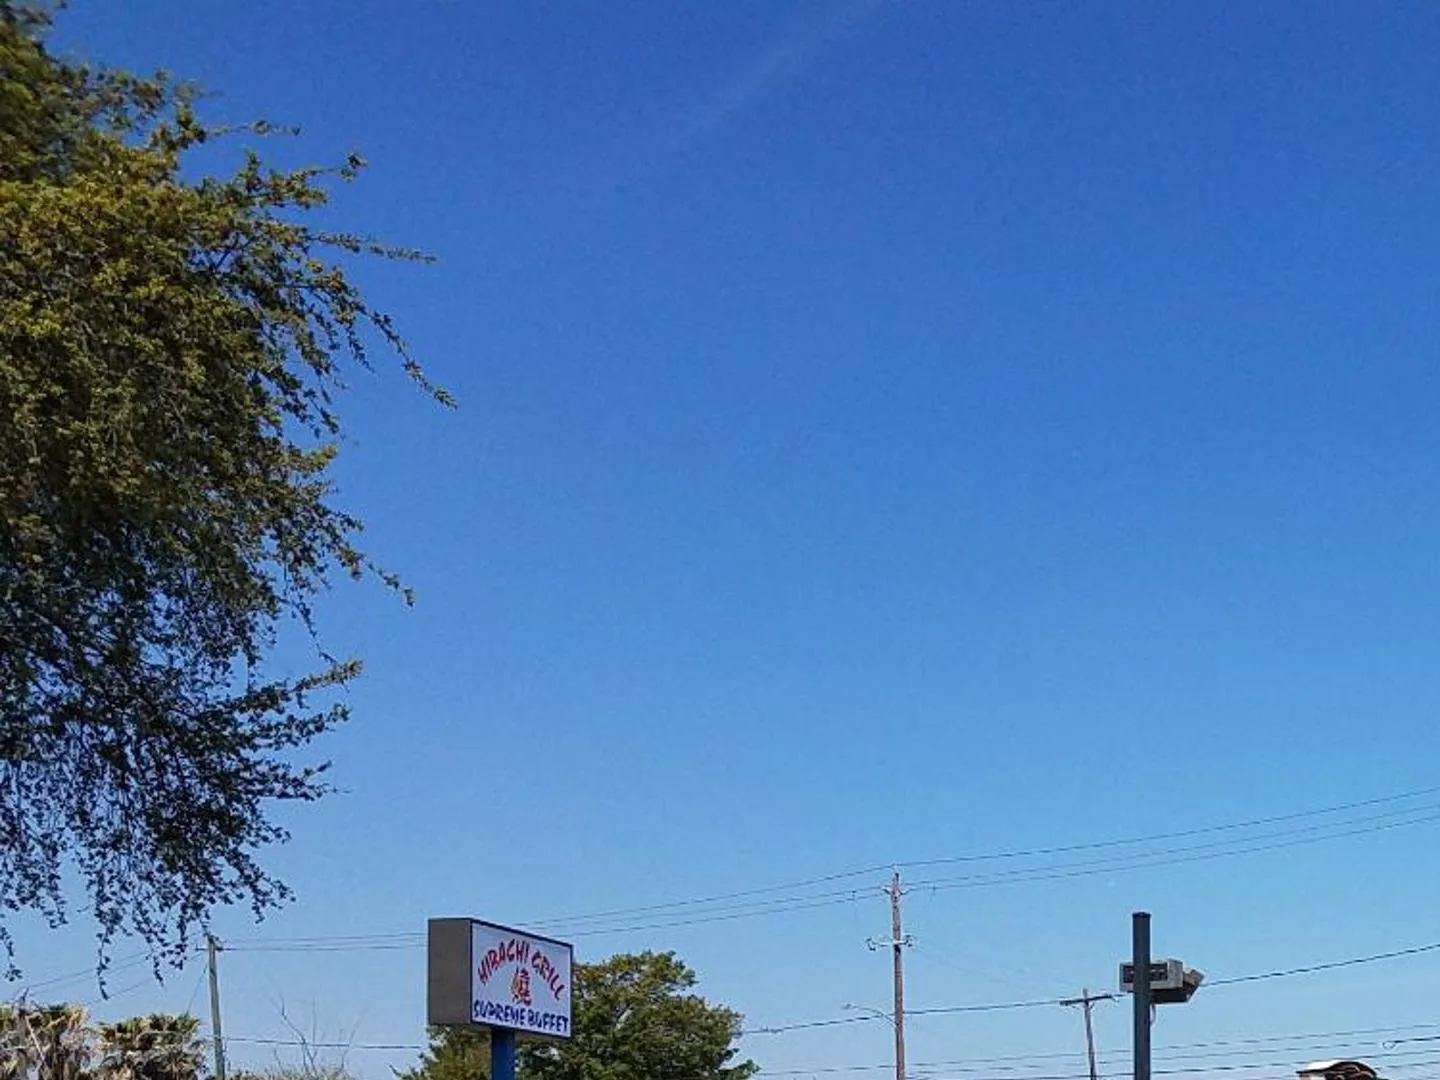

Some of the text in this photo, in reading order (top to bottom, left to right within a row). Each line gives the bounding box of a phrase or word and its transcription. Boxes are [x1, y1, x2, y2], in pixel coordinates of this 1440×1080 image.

[478, 938, 565, 1001] HIBACHI GRILL
[473, 999, 569, 1032] SUPREME BUFFET
